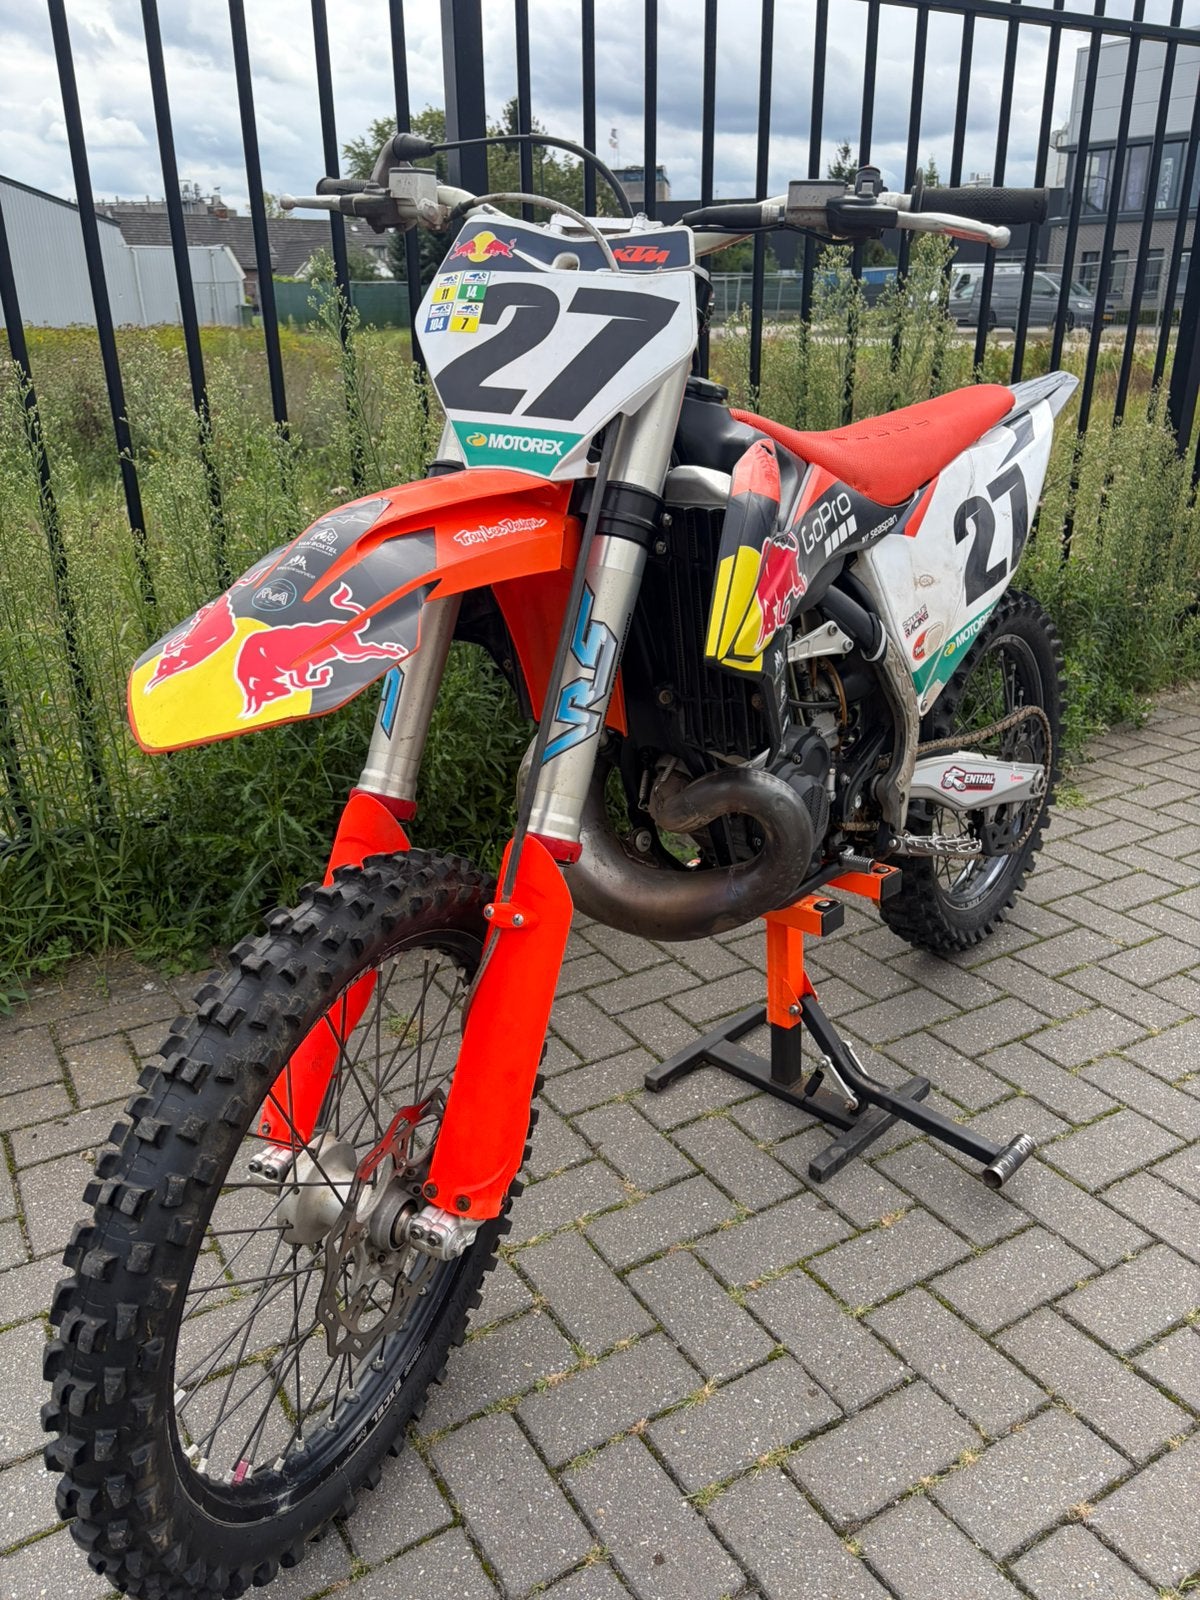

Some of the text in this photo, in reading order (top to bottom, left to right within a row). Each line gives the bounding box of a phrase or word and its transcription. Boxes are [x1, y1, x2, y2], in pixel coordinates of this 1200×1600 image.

[613, 245, 670, 263] KTM
[441, 288, 450, 300] 11
[466, 285, 478, 298] 14
[429, 318, 444, 331] 104
[460, 317, 469, 330] 7
[434, 282, 680, 421] 27
[488, 432, 564, 456] MOTOREX
[801, 492, 852, 553] GoPro
[954, 463, 1029, 608] 27
